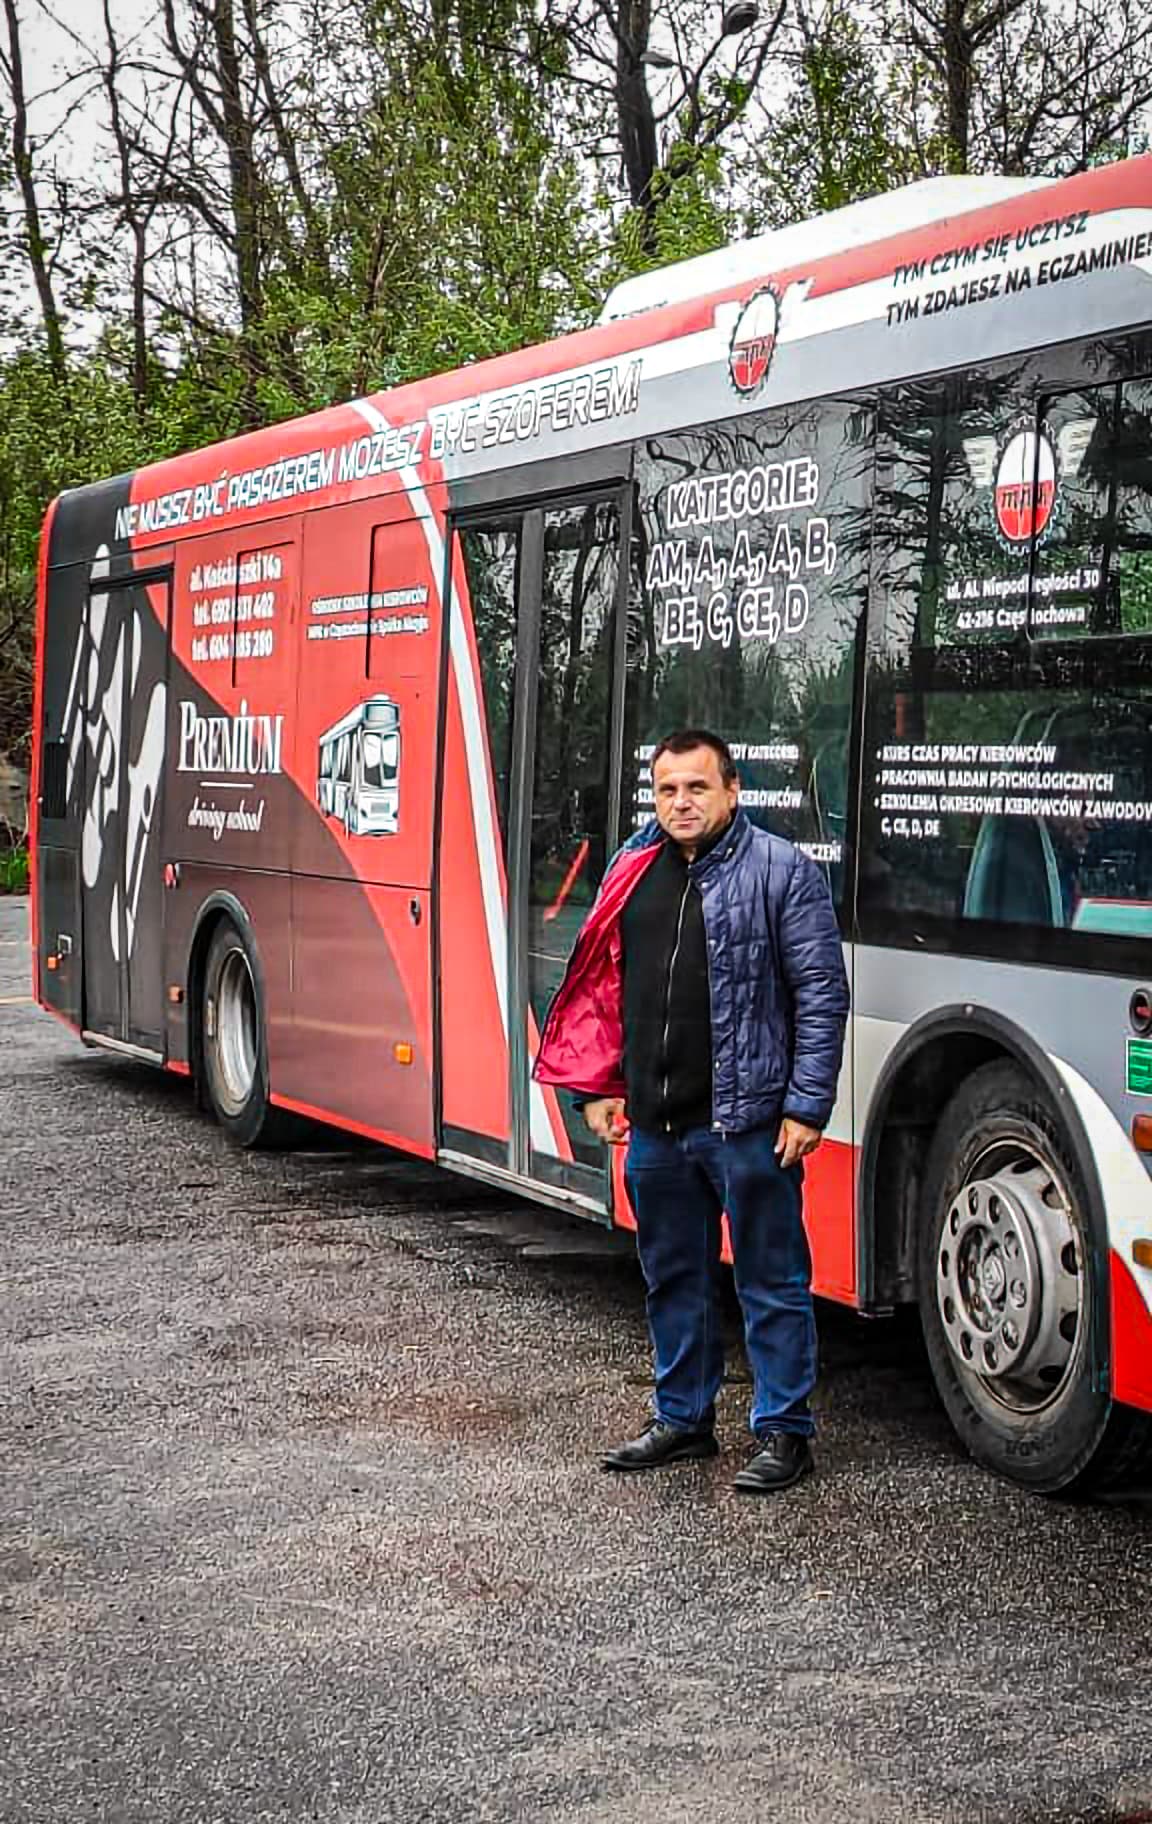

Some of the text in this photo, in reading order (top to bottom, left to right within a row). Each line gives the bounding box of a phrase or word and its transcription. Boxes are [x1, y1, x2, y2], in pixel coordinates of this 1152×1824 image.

[886, 231, 1152, 327] TYM ZDAJESZ NA EGZAMINIE!
[893, 210, 1090, 288] TYM CZYM SIĘ UCZYSZ
[138, 487, 194, 534] MUSISZ
[193, 470, 229, 520] BYĆ
[227, 446, 337, 514] PASAŻEREM
[337, 420, 427, 485] MOŻESZ
[429, 398, 481, 460] BYĆ
[481, 358, 644, 448] SZOFEREM!
[666, 457, 819, 529] KATEGORIE:
[645, 539, 692, 594] AM,
[805, 517, 837, 575] B,
[1083, 569, 1100, 588] 30
[661, 583, 809, 650] BE, C, CE, D
[881, 769, 947, 787] PRACOWNIA
[989, 772, 1114, 792] PSYCHOLOGICZNYCH
[882, 741, 1057, 763] KURS CZAS PRACY KIEROWCÓW
[880, 793, 938, 812] SZKOLENIA
[938, 795, 1003, 815] OKRESOWE
[1003, 795, 1083, 817] KIEROWCÓW
